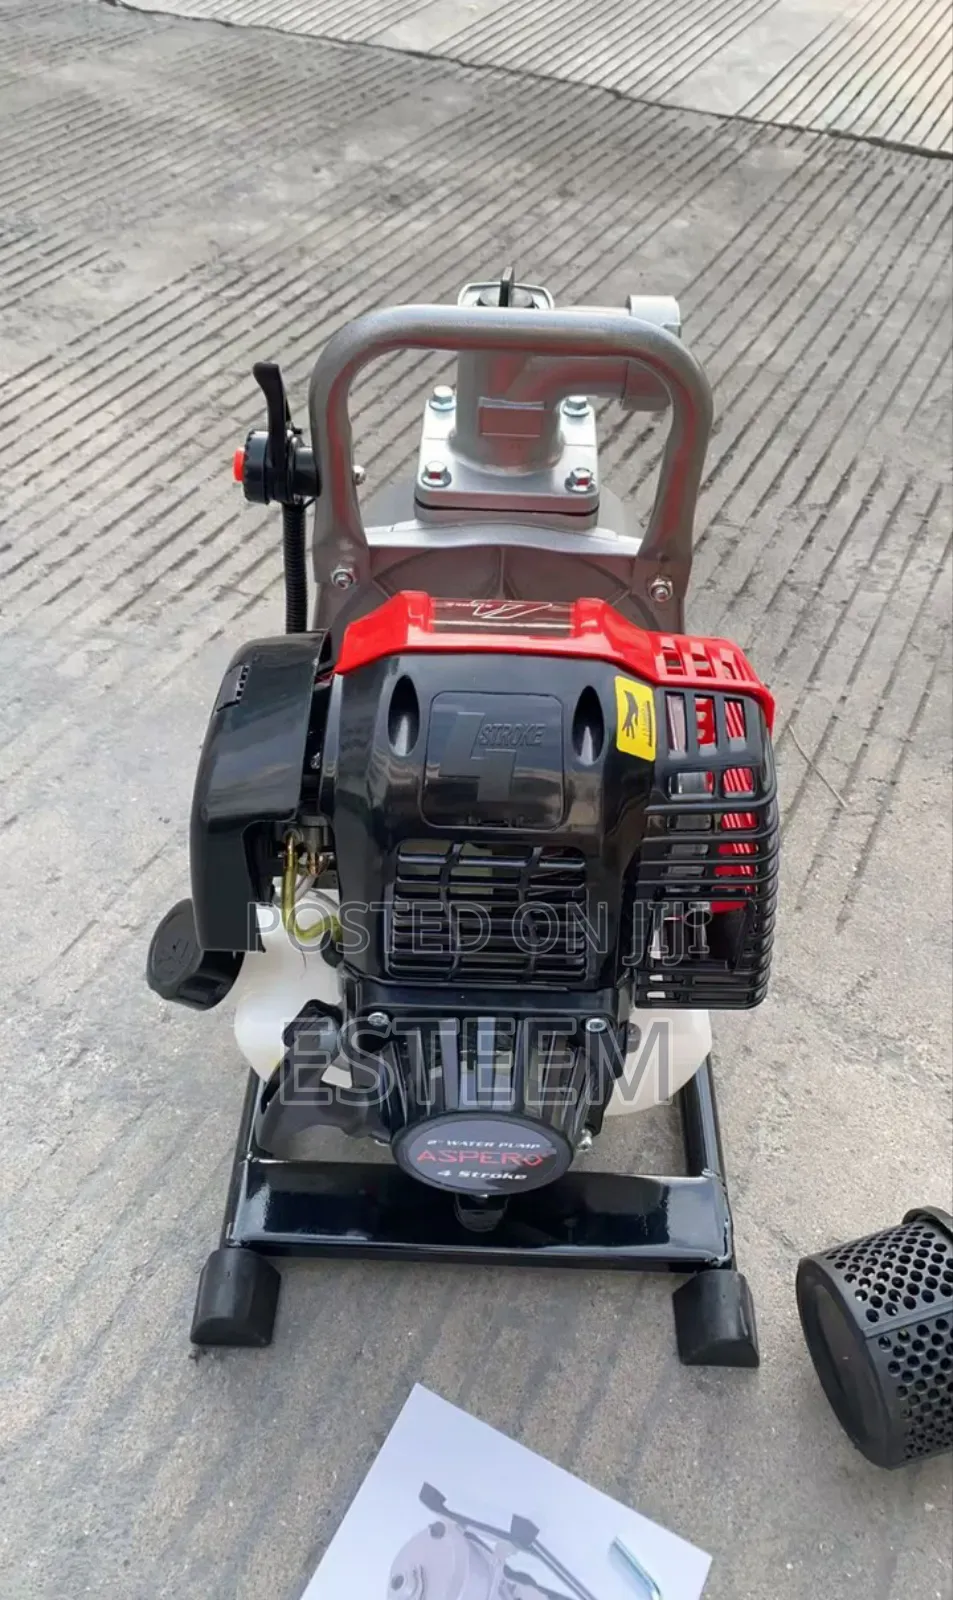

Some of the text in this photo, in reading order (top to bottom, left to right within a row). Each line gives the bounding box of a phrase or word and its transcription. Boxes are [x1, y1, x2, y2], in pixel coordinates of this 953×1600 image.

[479, 722, 547, 747] STROKE
[498, 1142, 541, 1150] PUMP
[416, 1149, 544, 1168] ASPERO
[437, 1170, 528, 1180] 4 Stroke
